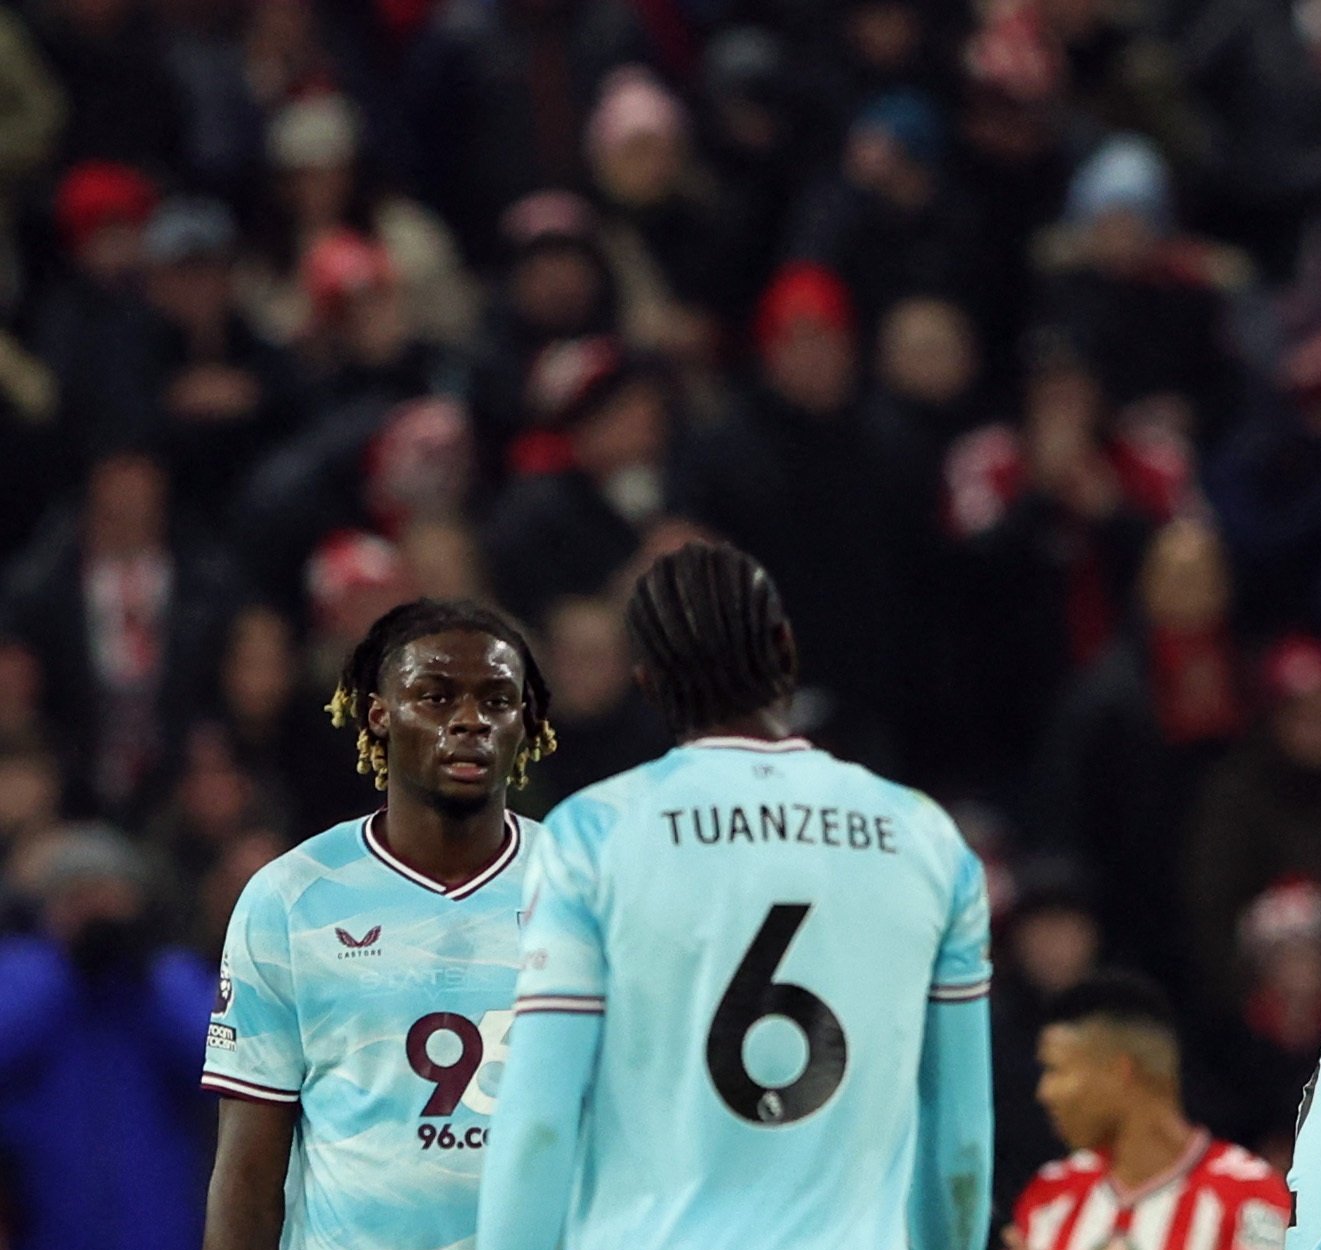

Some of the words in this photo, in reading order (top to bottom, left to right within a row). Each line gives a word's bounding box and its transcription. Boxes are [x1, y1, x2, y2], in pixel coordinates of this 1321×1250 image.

[662, 804, 899, 853] TUANZEBE
[337, 948, 383, 960] CASTORE
[705, 901, 850, 1127] 6
